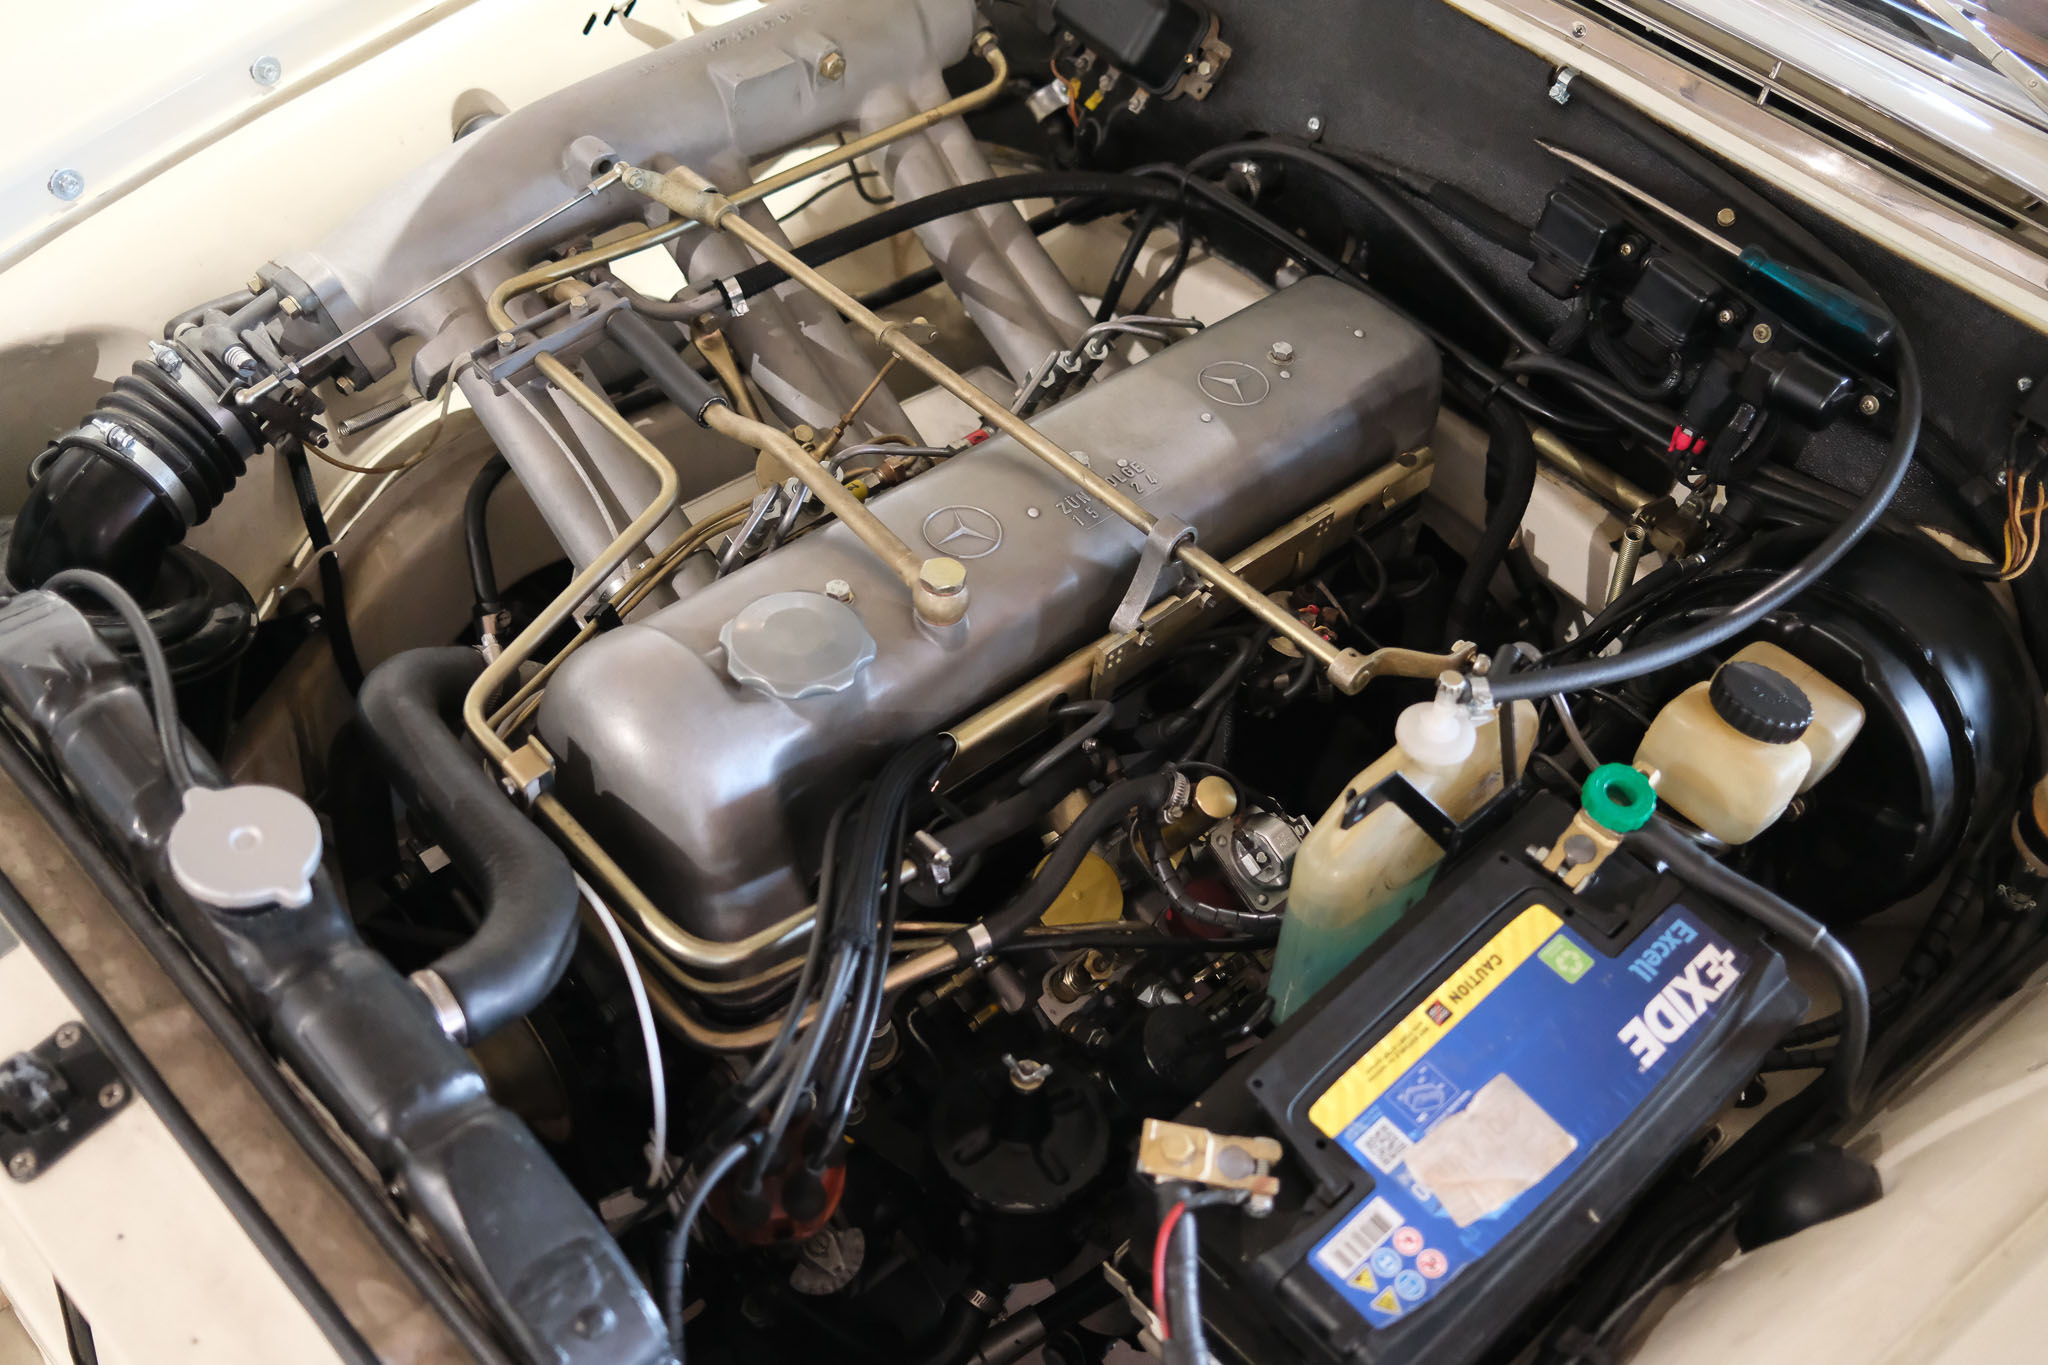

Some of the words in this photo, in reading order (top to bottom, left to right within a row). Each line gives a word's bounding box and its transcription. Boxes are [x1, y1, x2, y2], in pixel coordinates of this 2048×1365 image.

[1449, 953, 1503, 1004] CAUTION
[1627, 918, 1699, 983] Excell
[1617, 943, 1740, 1073] EXIDE
